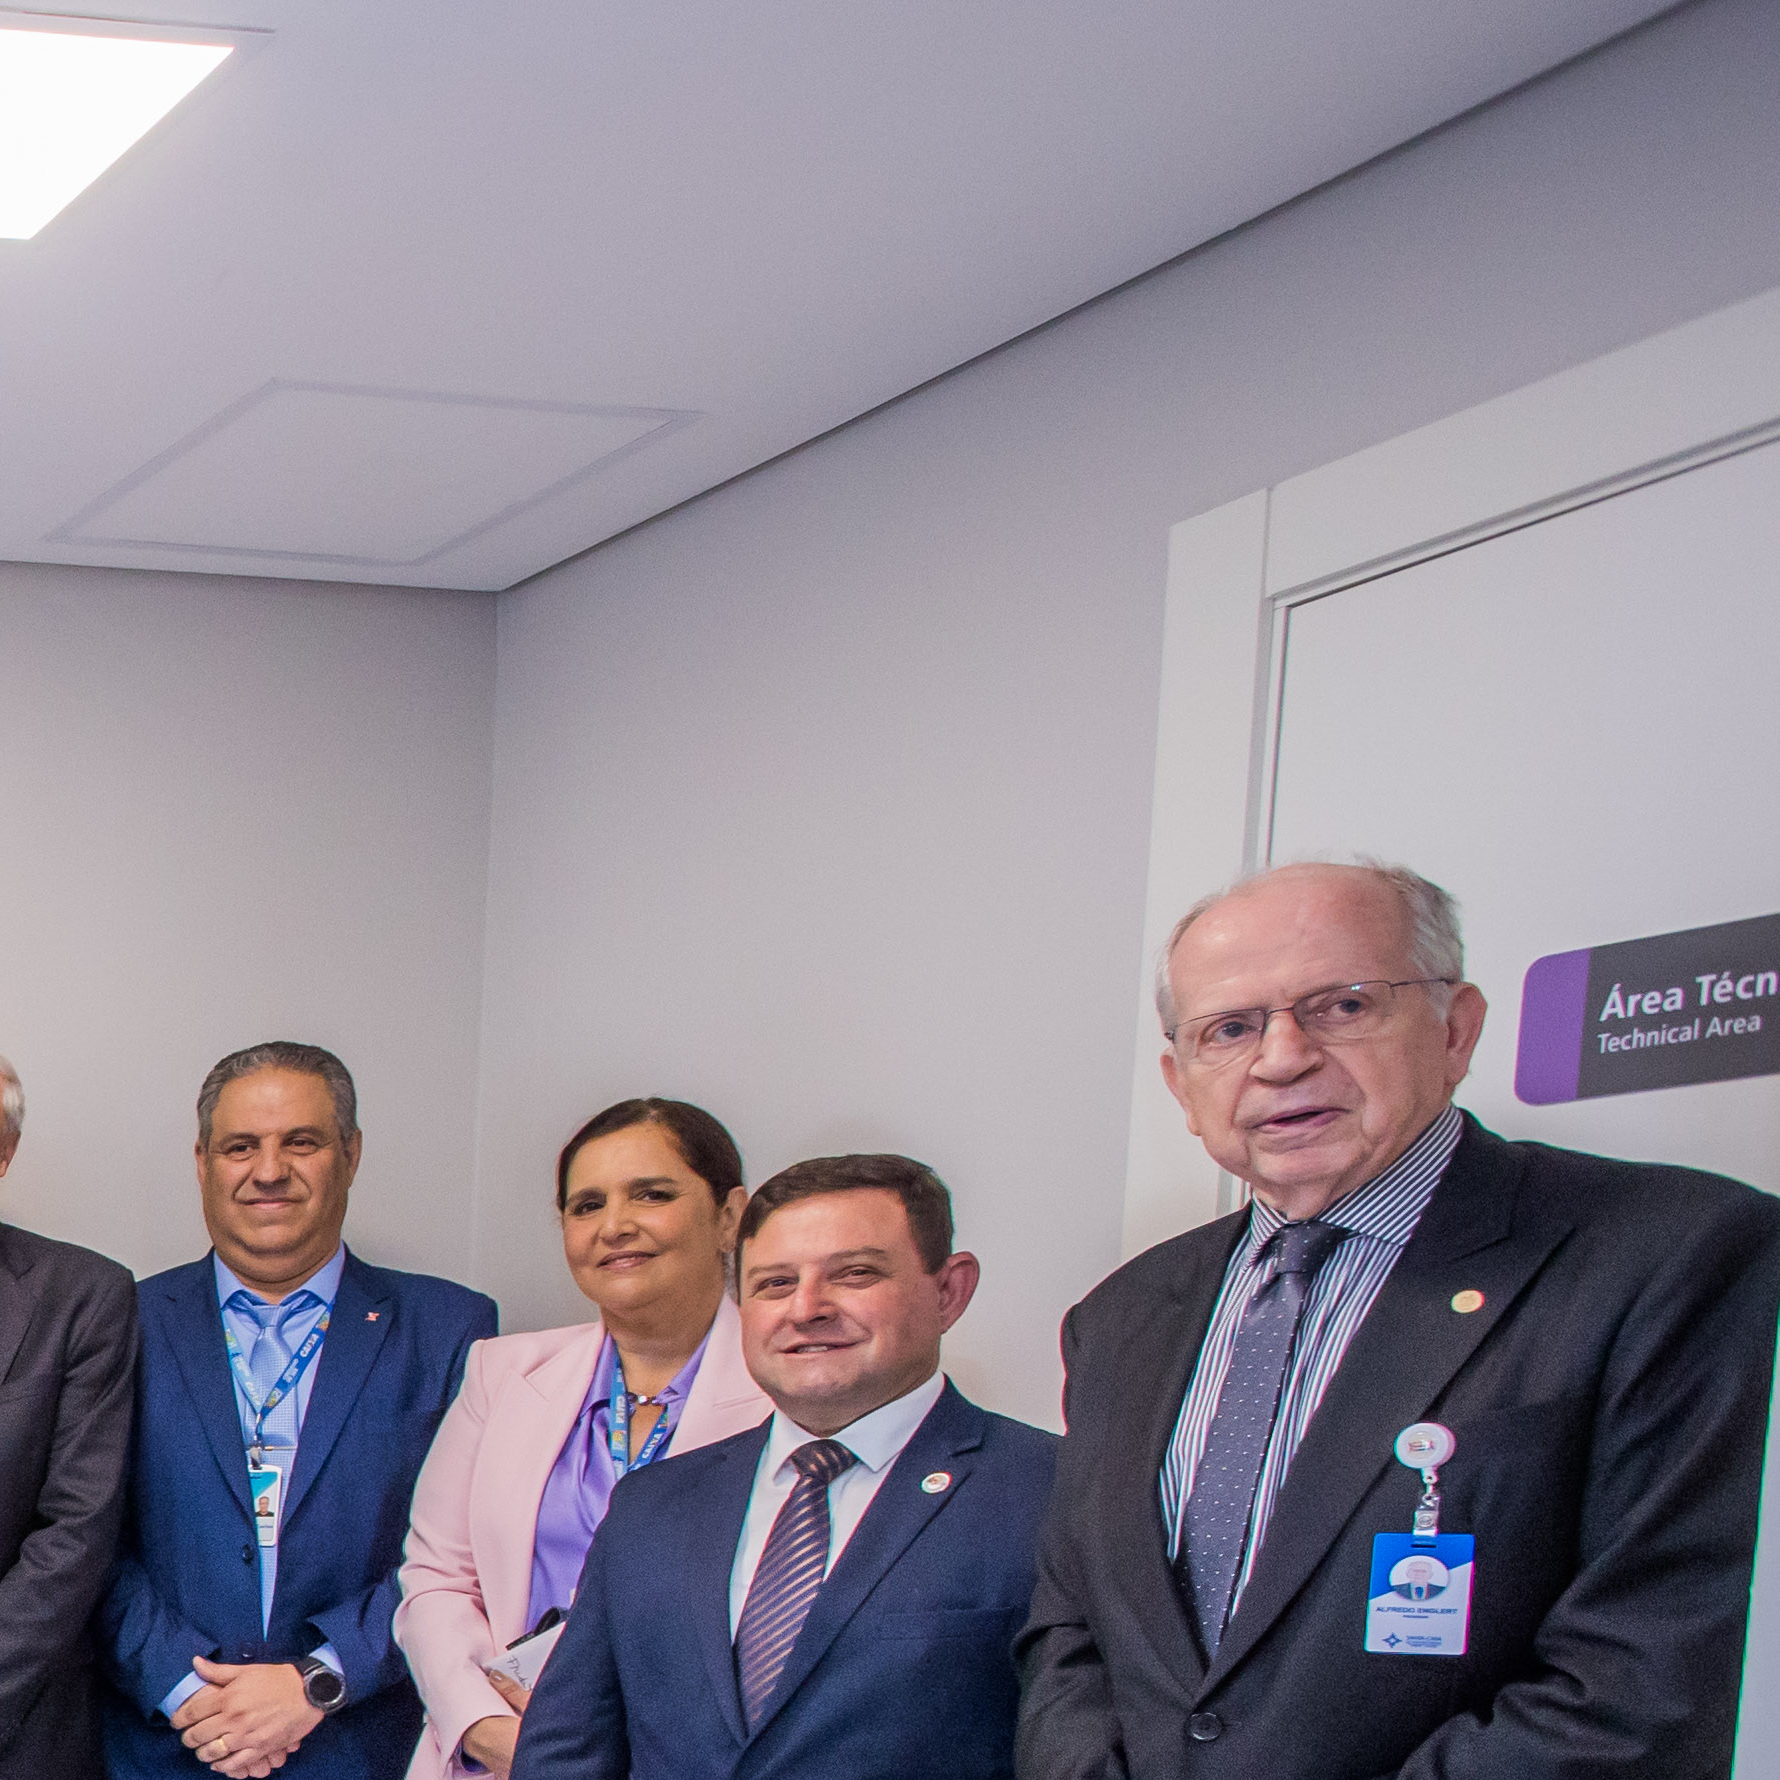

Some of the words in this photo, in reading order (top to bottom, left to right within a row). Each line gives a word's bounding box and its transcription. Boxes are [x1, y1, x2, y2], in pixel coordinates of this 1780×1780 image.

[1599, 982, 1684, 1022] Área
[1695, 970, 1779, 1006] Técn
[1597, 1018, 1700, 1054] Technical
[1705, 1014, 1762, 1039] Area
